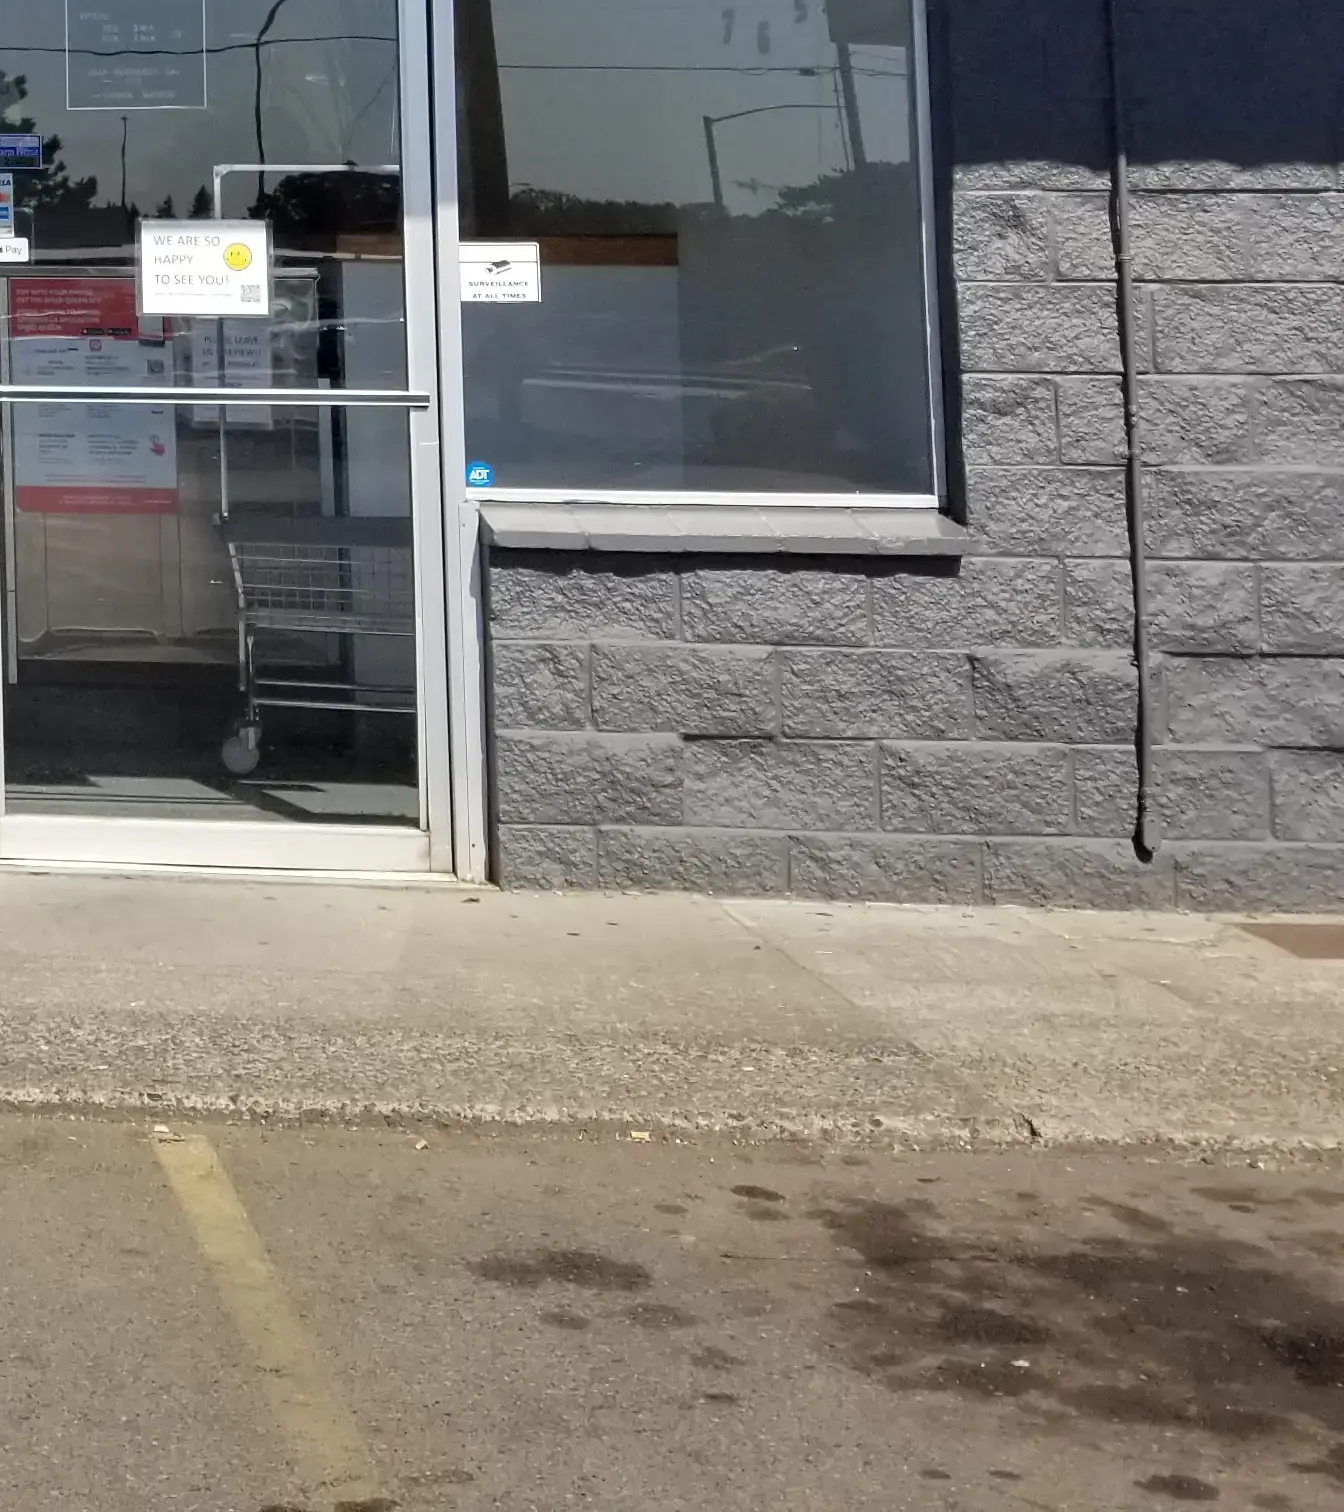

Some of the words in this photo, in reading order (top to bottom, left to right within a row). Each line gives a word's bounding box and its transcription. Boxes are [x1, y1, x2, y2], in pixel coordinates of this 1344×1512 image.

[154, 236, 173, 246] WE
[177, 236, 201, 246] ARE
[204, 236, 221, 247] SO
[5, 246, 23, 255] Pay
[154, 254, 194, 265] HAPPY
[155, 274, 171, 285] TO
[174, 275, 195, 285] SEE
[198, 275, 230, 286] YOU!
[469, 469, 490, 480] ADT
